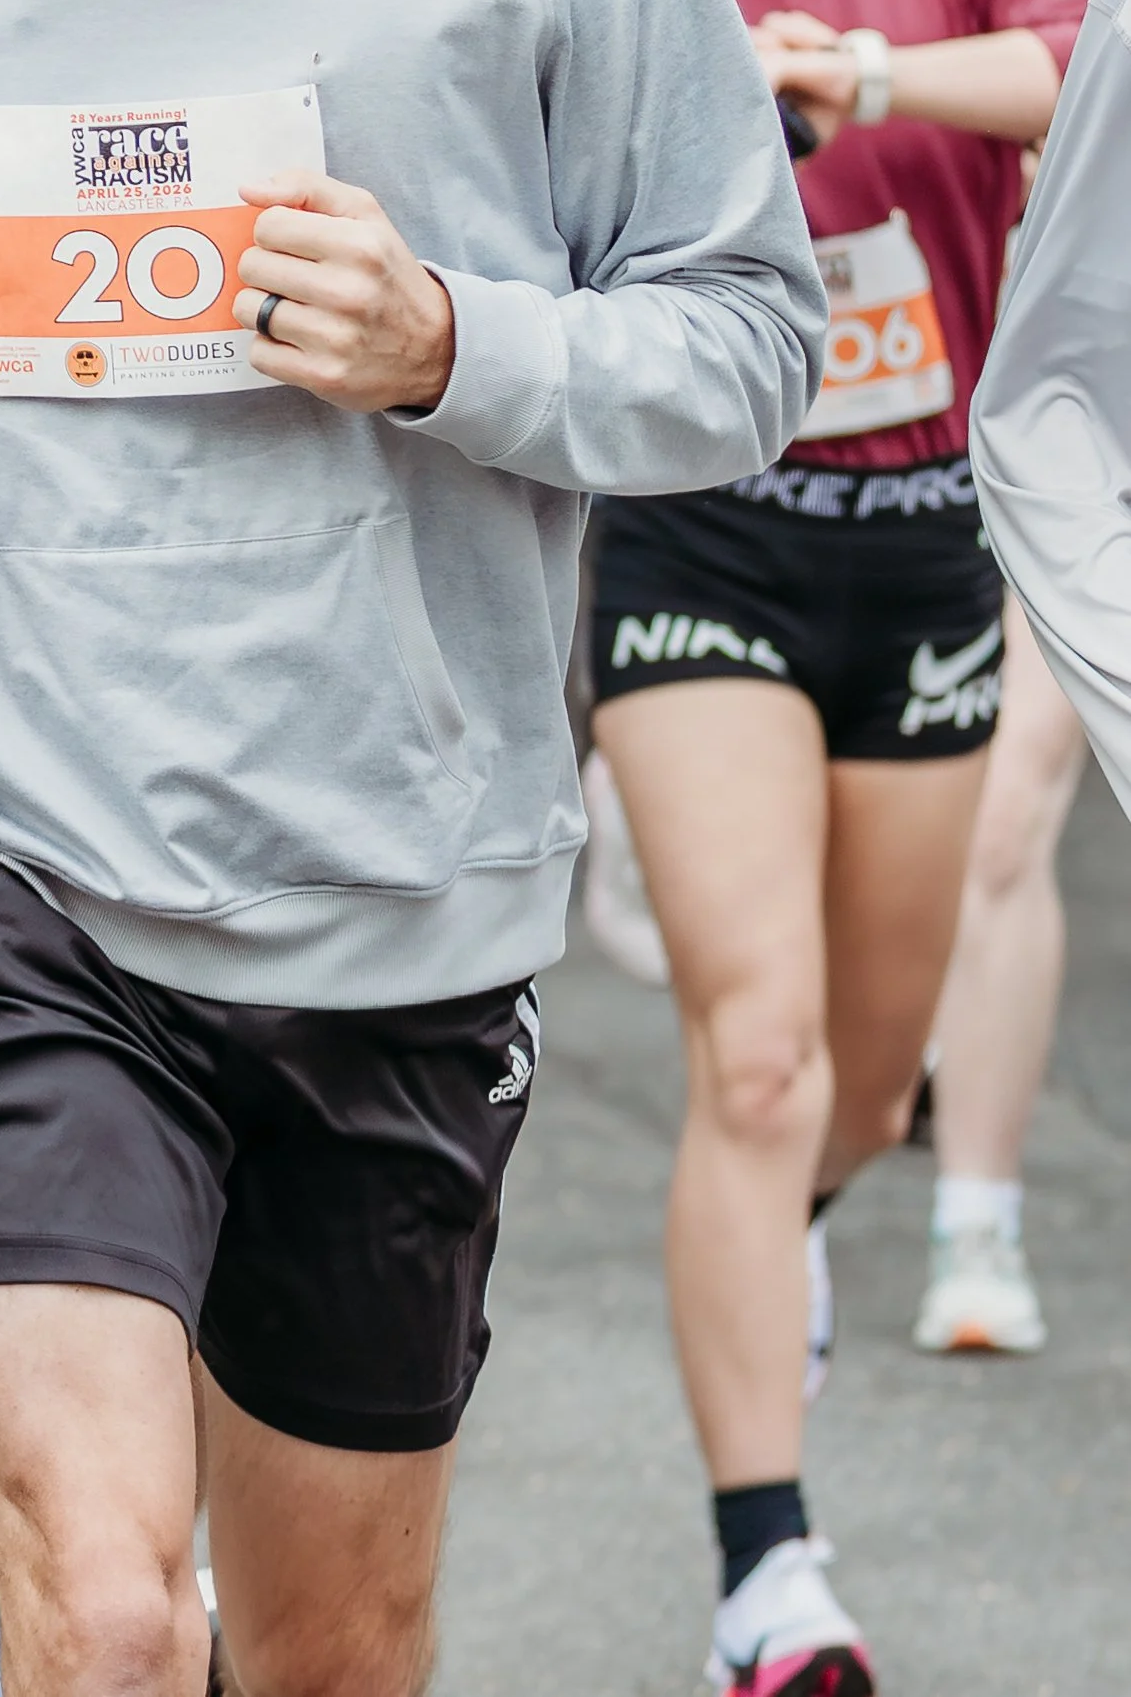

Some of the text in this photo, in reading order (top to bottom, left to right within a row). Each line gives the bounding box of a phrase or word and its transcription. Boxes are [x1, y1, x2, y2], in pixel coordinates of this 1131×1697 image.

[70, 107, 188, 124] 28 Years Running!
[88, 123, 190, 158] race
[71, 127, 92, 186] ywca
[93, 152, 188, 174] against
[91, 164, 192, 187] RACISM
[76, 184, 193, 200] APRIL 25, 2026
[174, 196, 194, 208] PA
[51, 225, 226, 324] 20
[120, 367, 238, 380] PAINTING COMPANY
[721, 465, 855, 519] IKE
[898, 671, 1002, 737] PR
[488, 1064, 534, 1105] adid
